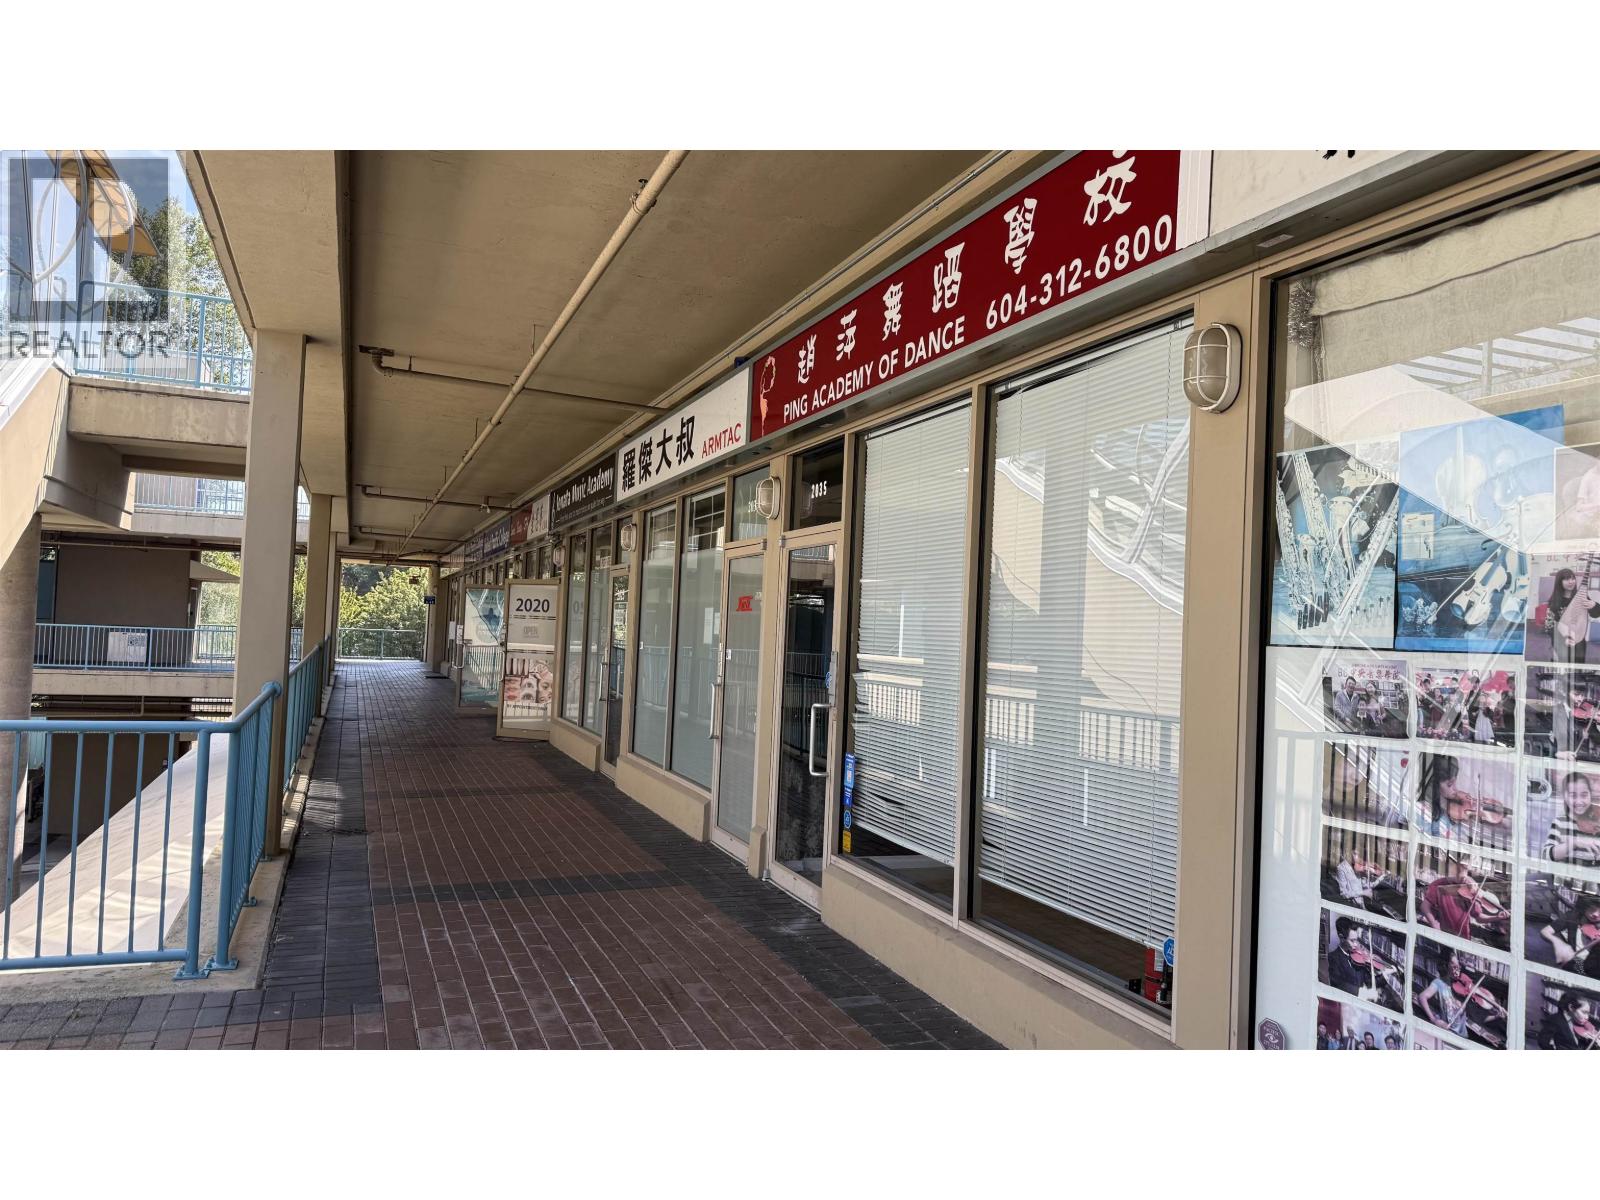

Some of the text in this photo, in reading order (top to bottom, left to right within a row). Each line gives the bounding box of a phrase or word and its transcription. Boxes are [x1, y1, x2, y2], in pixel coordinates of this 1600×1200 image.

[782, 213, 1173, 423] PING ACADEMY OF DANCE 604-312-6800
[621, 416, 695, 492] 羅傑大叔
[701, 423, 742, 459] ARMTAC
[586, 467, 614, 496] Academy
[811, 480, 827, 499] 2035
[515, 598, 550, 613] 2020
